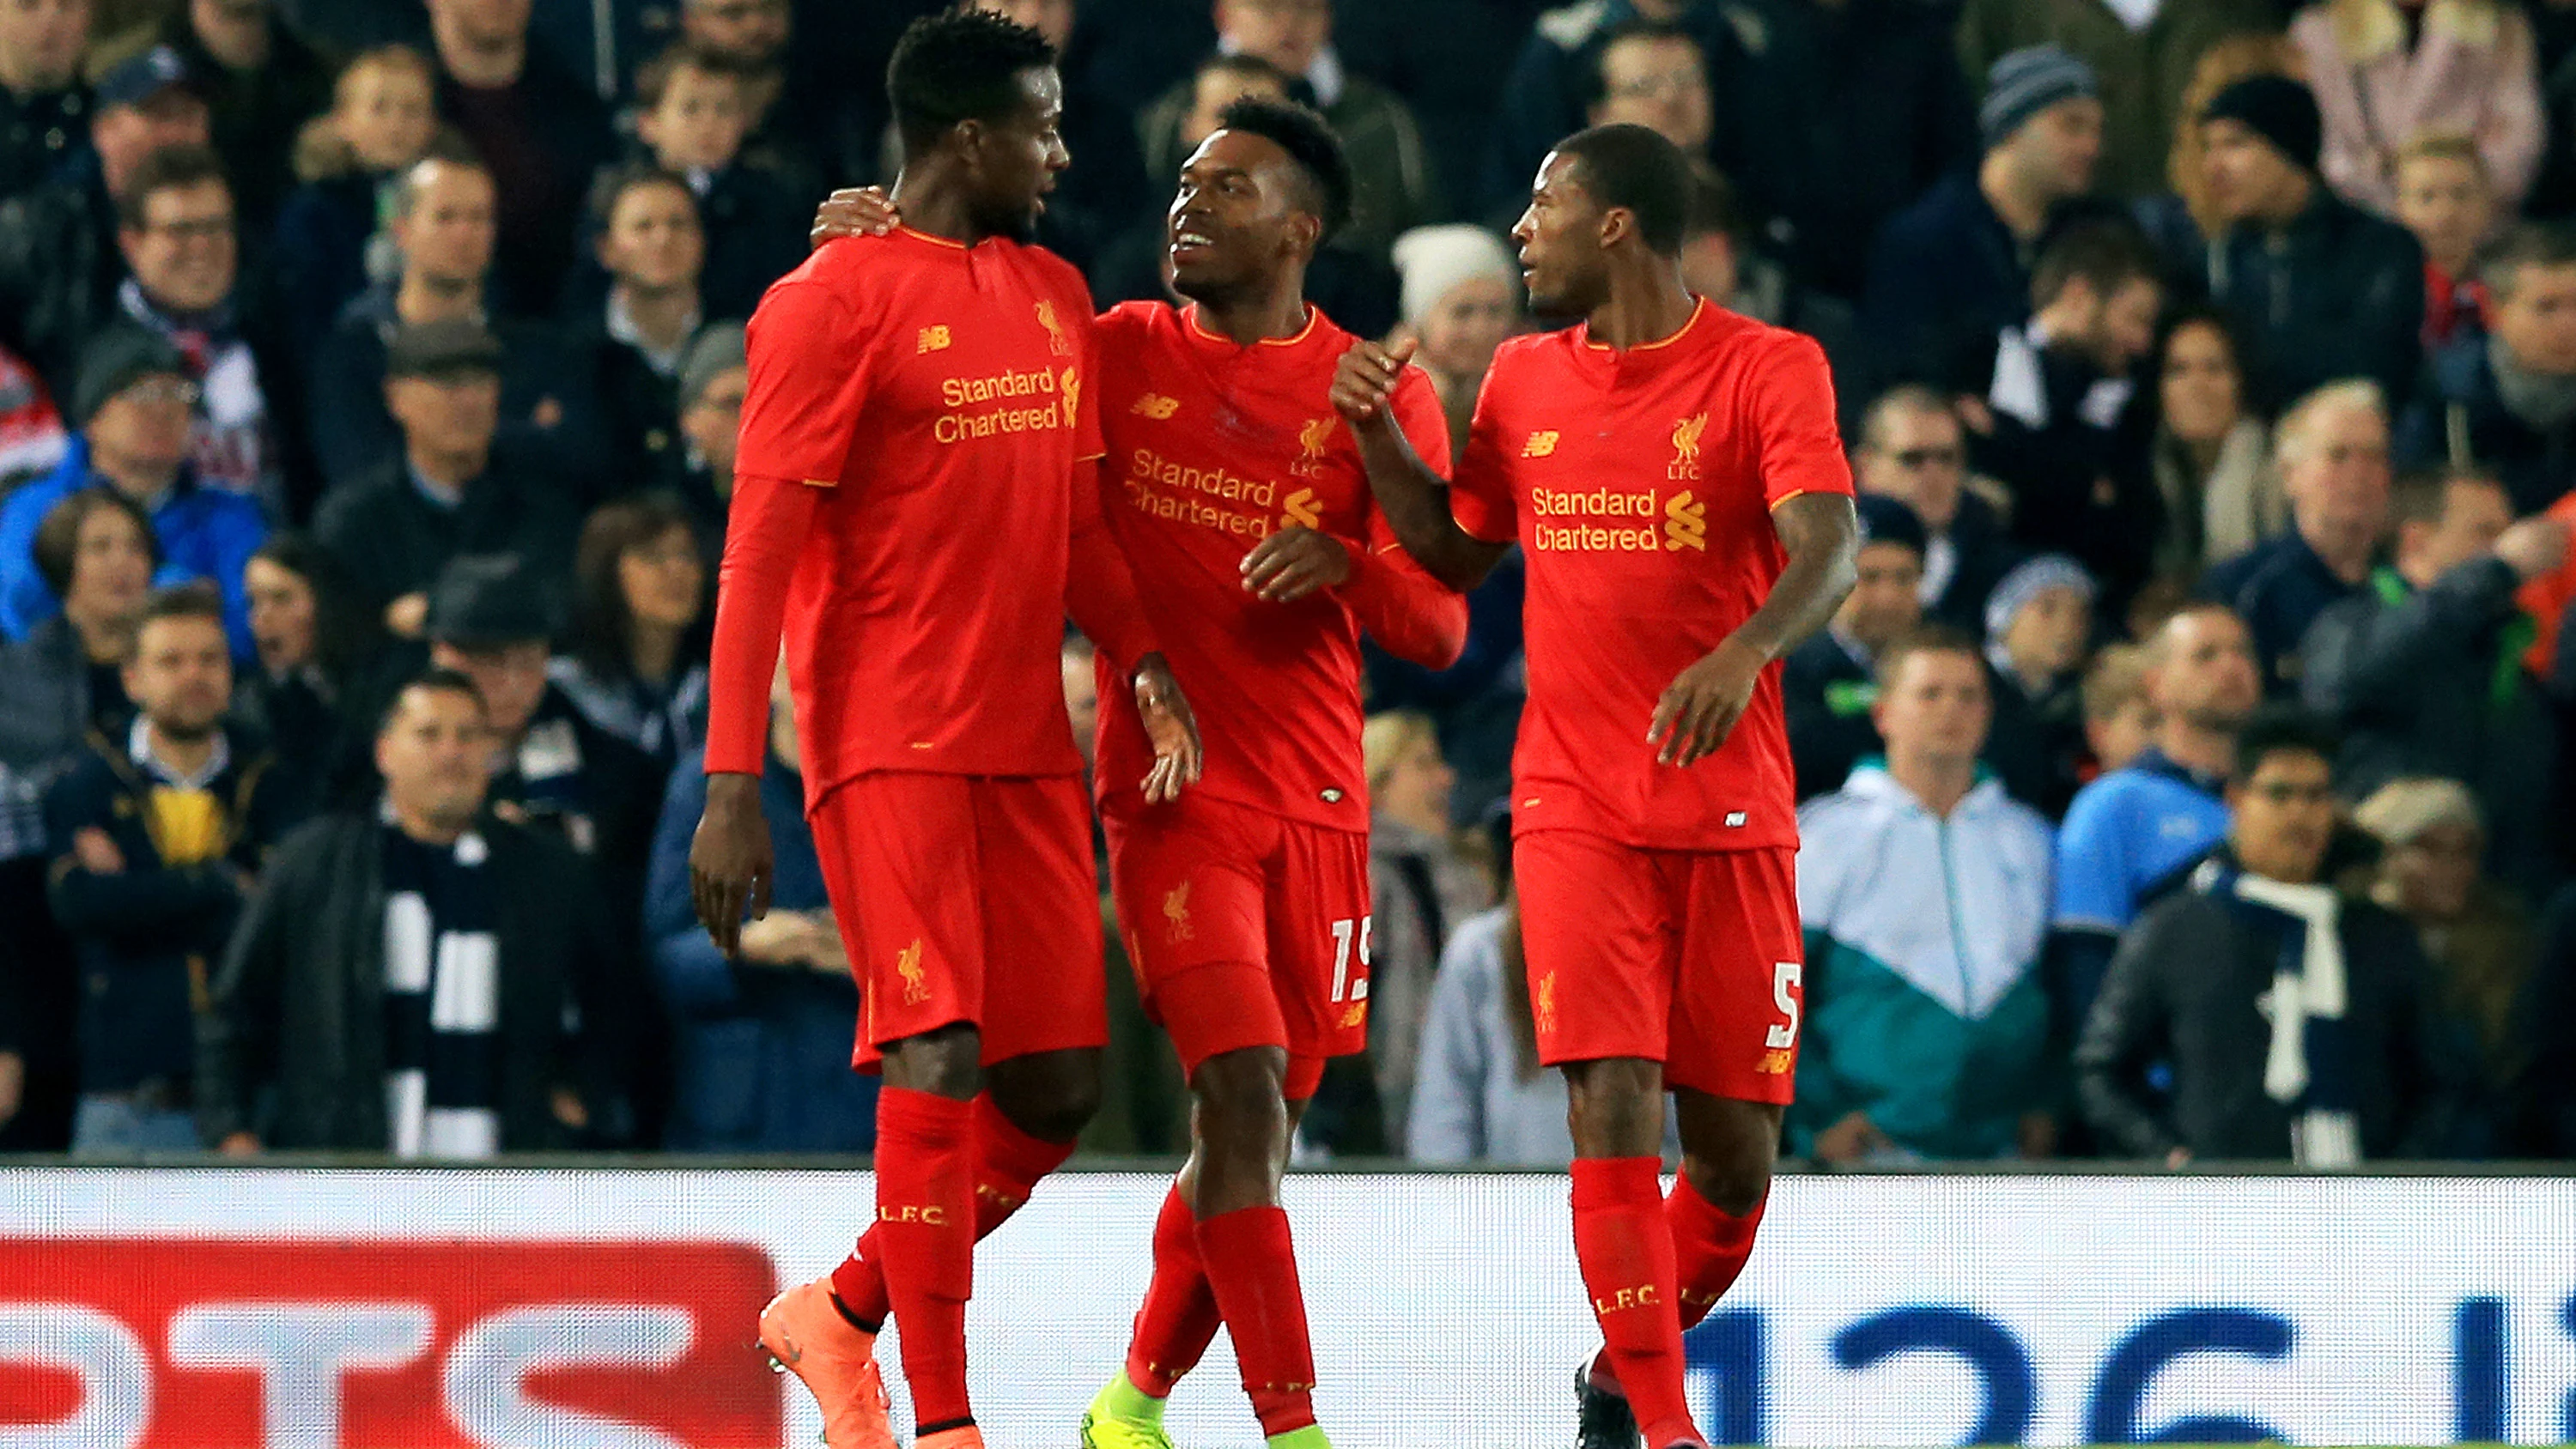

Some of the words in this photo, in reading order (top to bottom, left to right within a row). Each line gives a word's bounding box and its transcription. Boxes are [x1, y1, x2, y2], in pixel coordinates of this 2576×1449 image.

[943, 367, 1054, 408] Standard
[935, 403, 1057, 444] Chartered
[1133, 449, 1276, 507] Standard
[1532, 487, 1656, 517] Standard
[1535, 524, 1658, 551] Chartered
[1765, 962, 1801, 1048] 5
